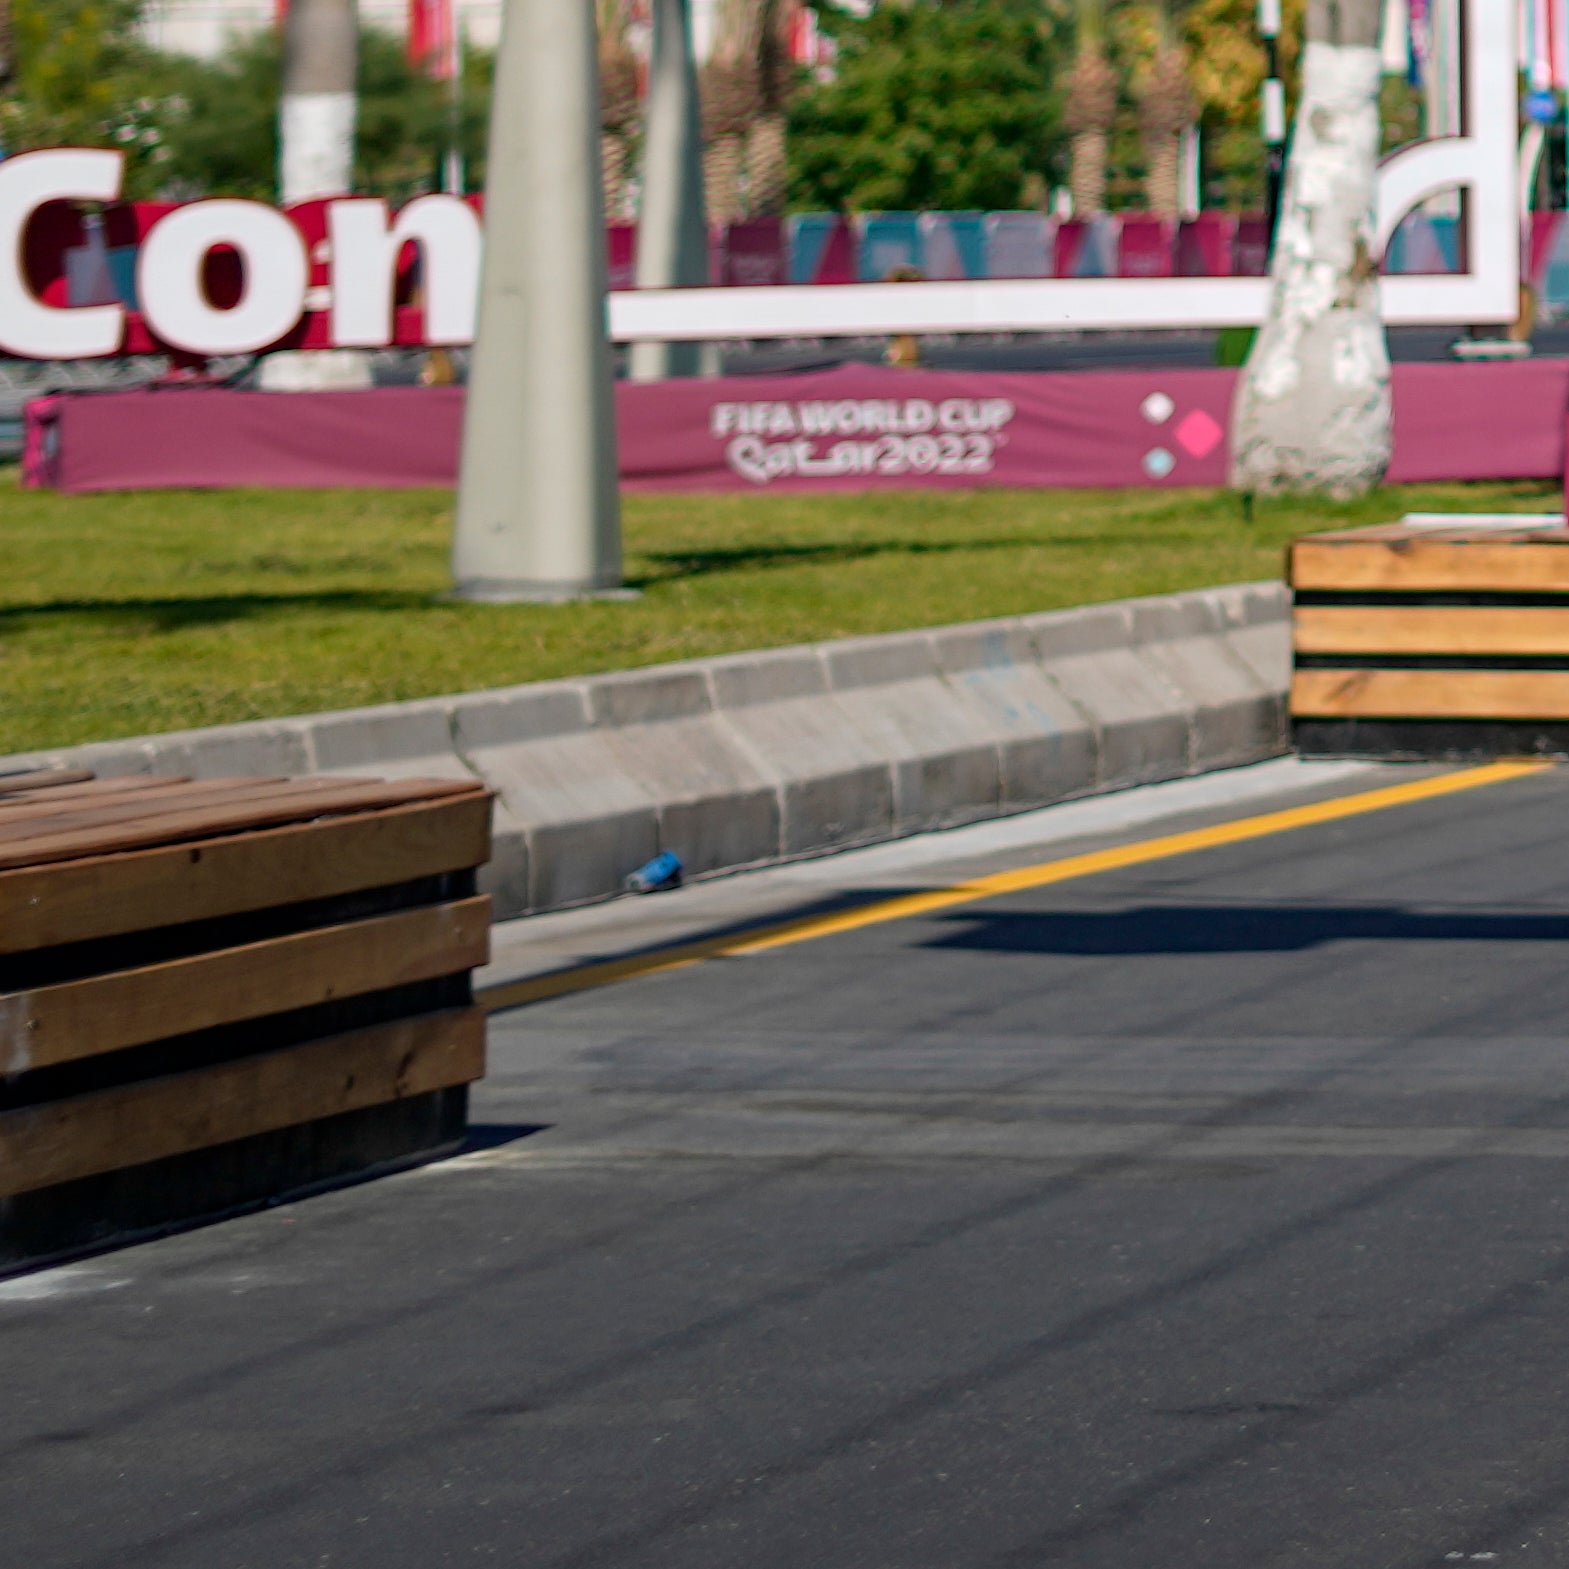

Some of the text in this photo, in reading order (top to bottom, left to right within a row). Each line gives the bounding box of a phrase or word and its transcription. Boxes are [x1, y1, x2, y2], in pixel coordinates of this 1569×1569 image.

[0, 146, 483, 358] Con
[711, 398, 1014, 437] FIFA WORLD CUP
